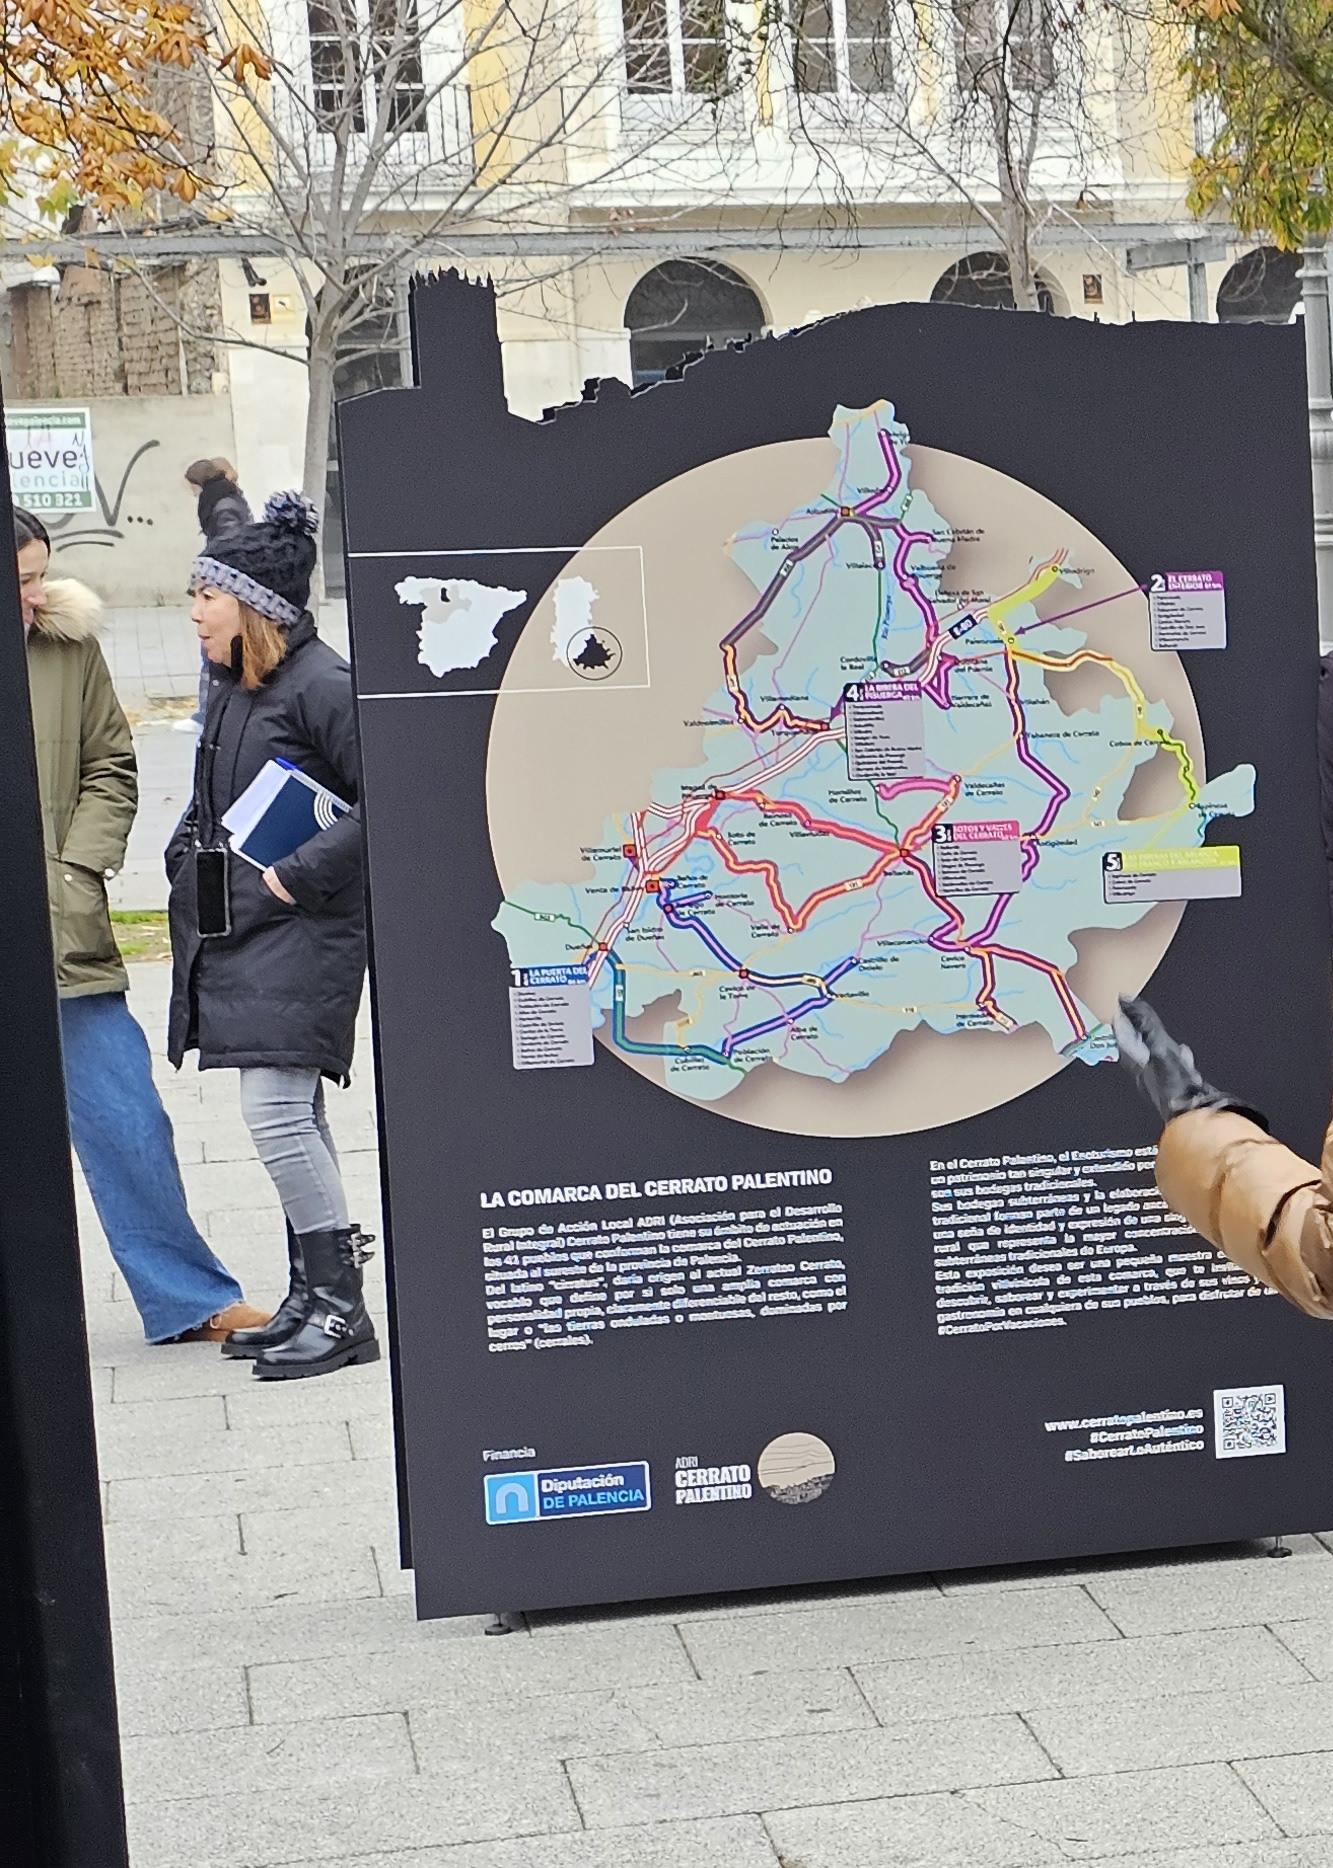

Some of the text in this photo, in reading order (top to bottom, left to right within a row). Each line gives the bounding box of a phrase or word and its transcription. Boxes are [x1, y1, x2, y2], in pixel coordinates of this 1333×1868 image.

[23, 493, 52, 507] 510
[1151, 574, 1163, 591] 2
[846, 685, 859, 700] 4
[935, 827, 947, 842] 3
[1107, 854, 1119, 870] 5
[512, 970, 521, 986] 1
[480, 1168, 832, 1208] LA COMARCA DEL CERRATO PALENTINO
[1044, 1408, 1204, 1432] www.cerratopalentino.es
[1090, 1423, 1205, 1444] #CerratoPalentino
[482, 1446, 536, 1462] Financia
[1064, 1438, 1205, 1463] #SaborearLoAuténtico
[675, 1456, 699, 1469] ADRI
[540, 1474, 625, 1495] Diputación
[675, 1464, 751, 1488] CERRATO
[543, 1488, 645, 1510] DE PALENCIA
[675, 1483, 752, 1506] PALENTINO
